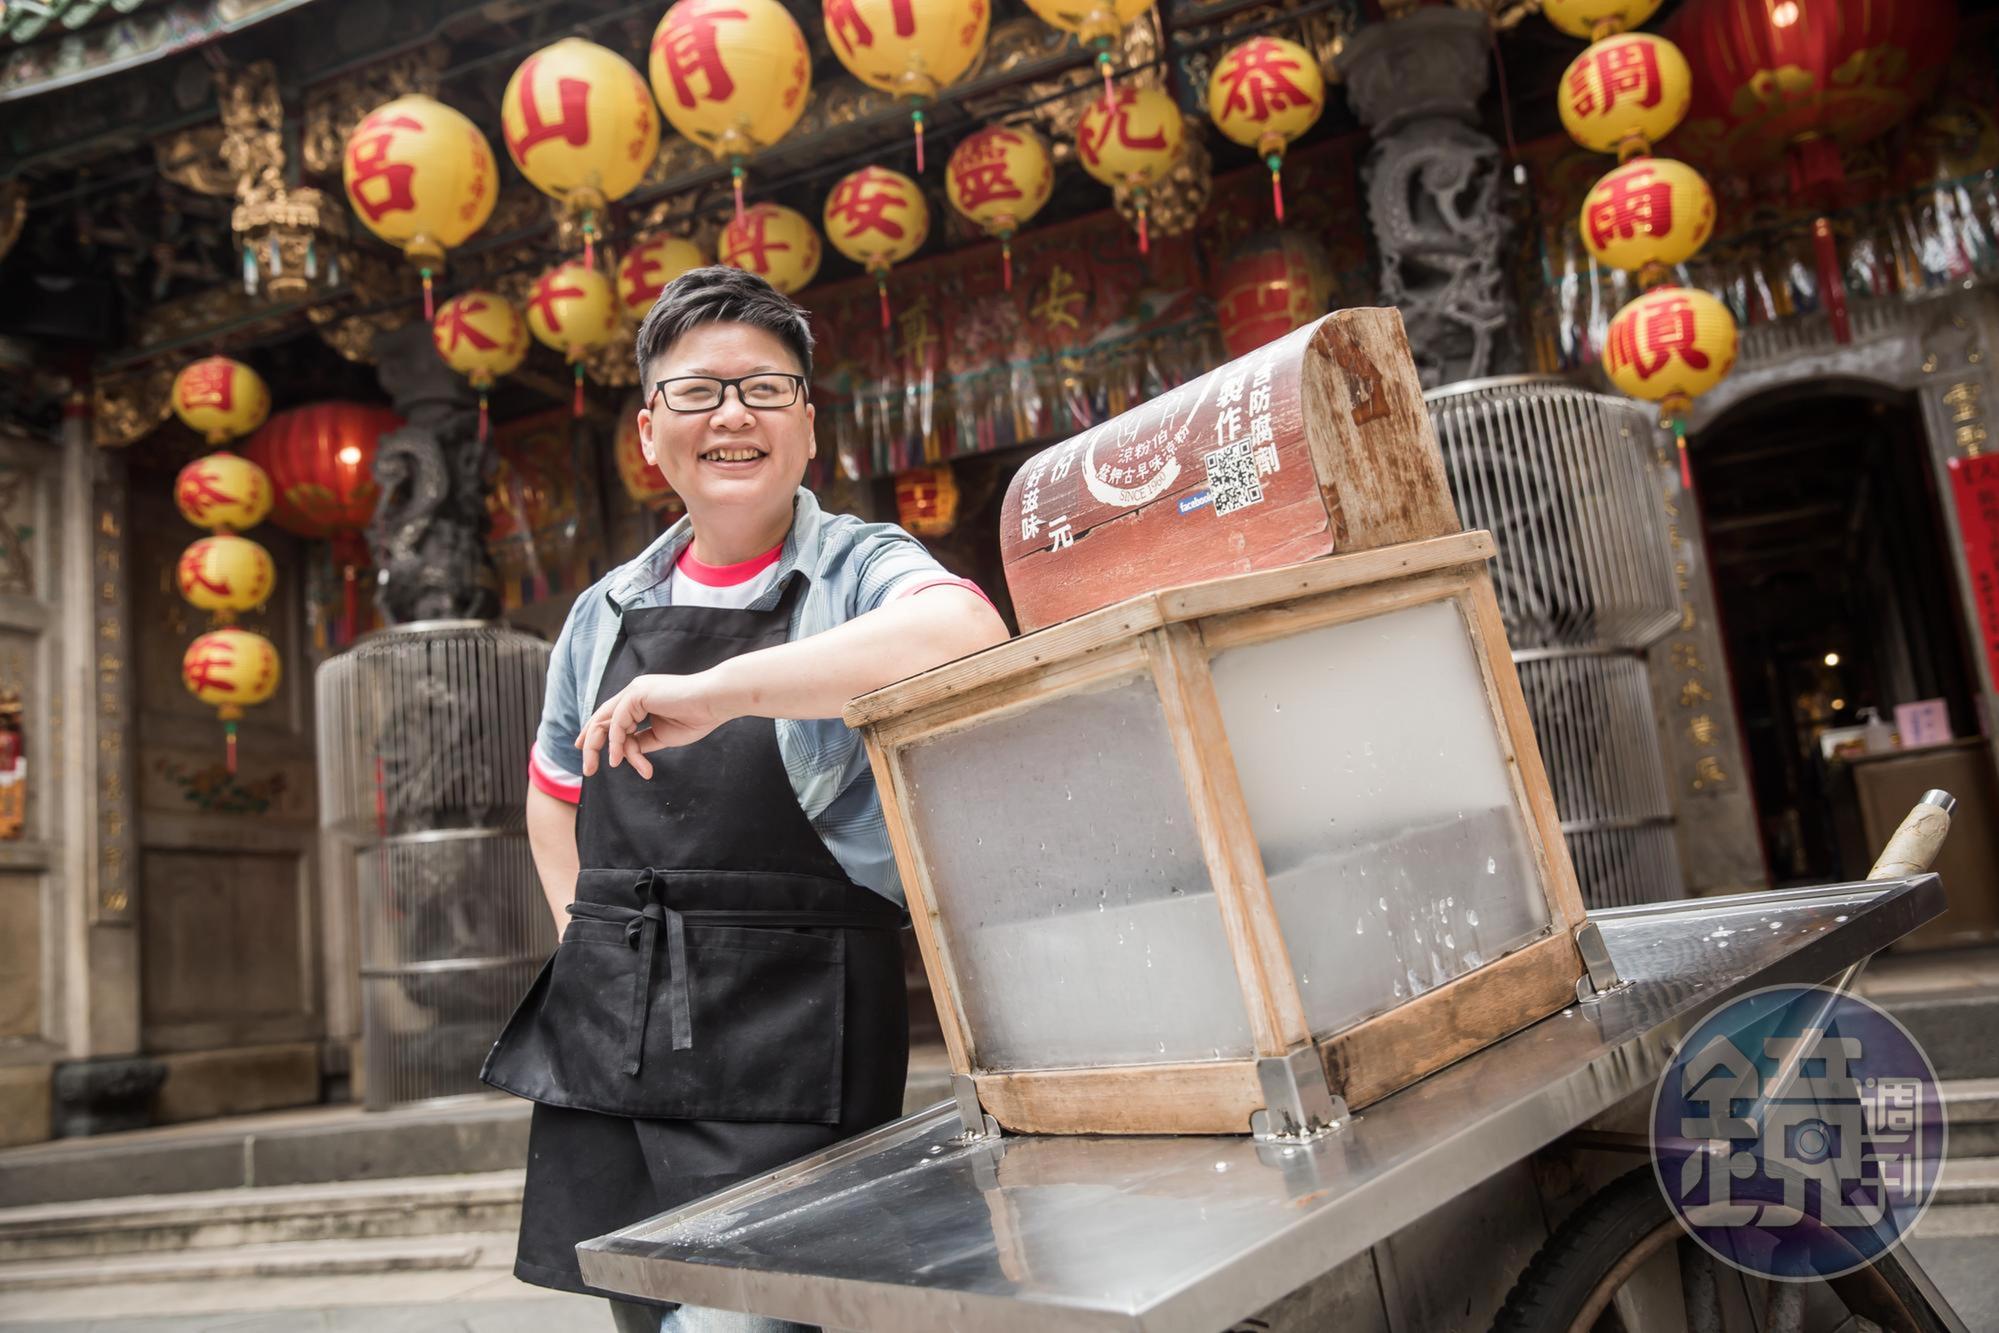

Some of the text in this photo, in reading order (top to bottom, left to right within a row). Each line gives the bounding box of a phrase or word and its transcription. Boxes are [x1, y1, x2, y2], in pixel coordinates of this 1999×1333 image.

[651, 0, 749, 109] 青
[1220, 36, 1312, 122] 恭
[1568, 41, 1662, 119] 調
[503, 55, 591, 166] 山
[828, 165, 908, 240] 安
[1589, 167, 1672, 250] 雨
[1607, 296, 1710, 380] 順
[1249, 349, 1281, 479] 含防腐劑
[1048, 515, 1074, 552] 元
[1120, 488, 1147, 502] SINCE
